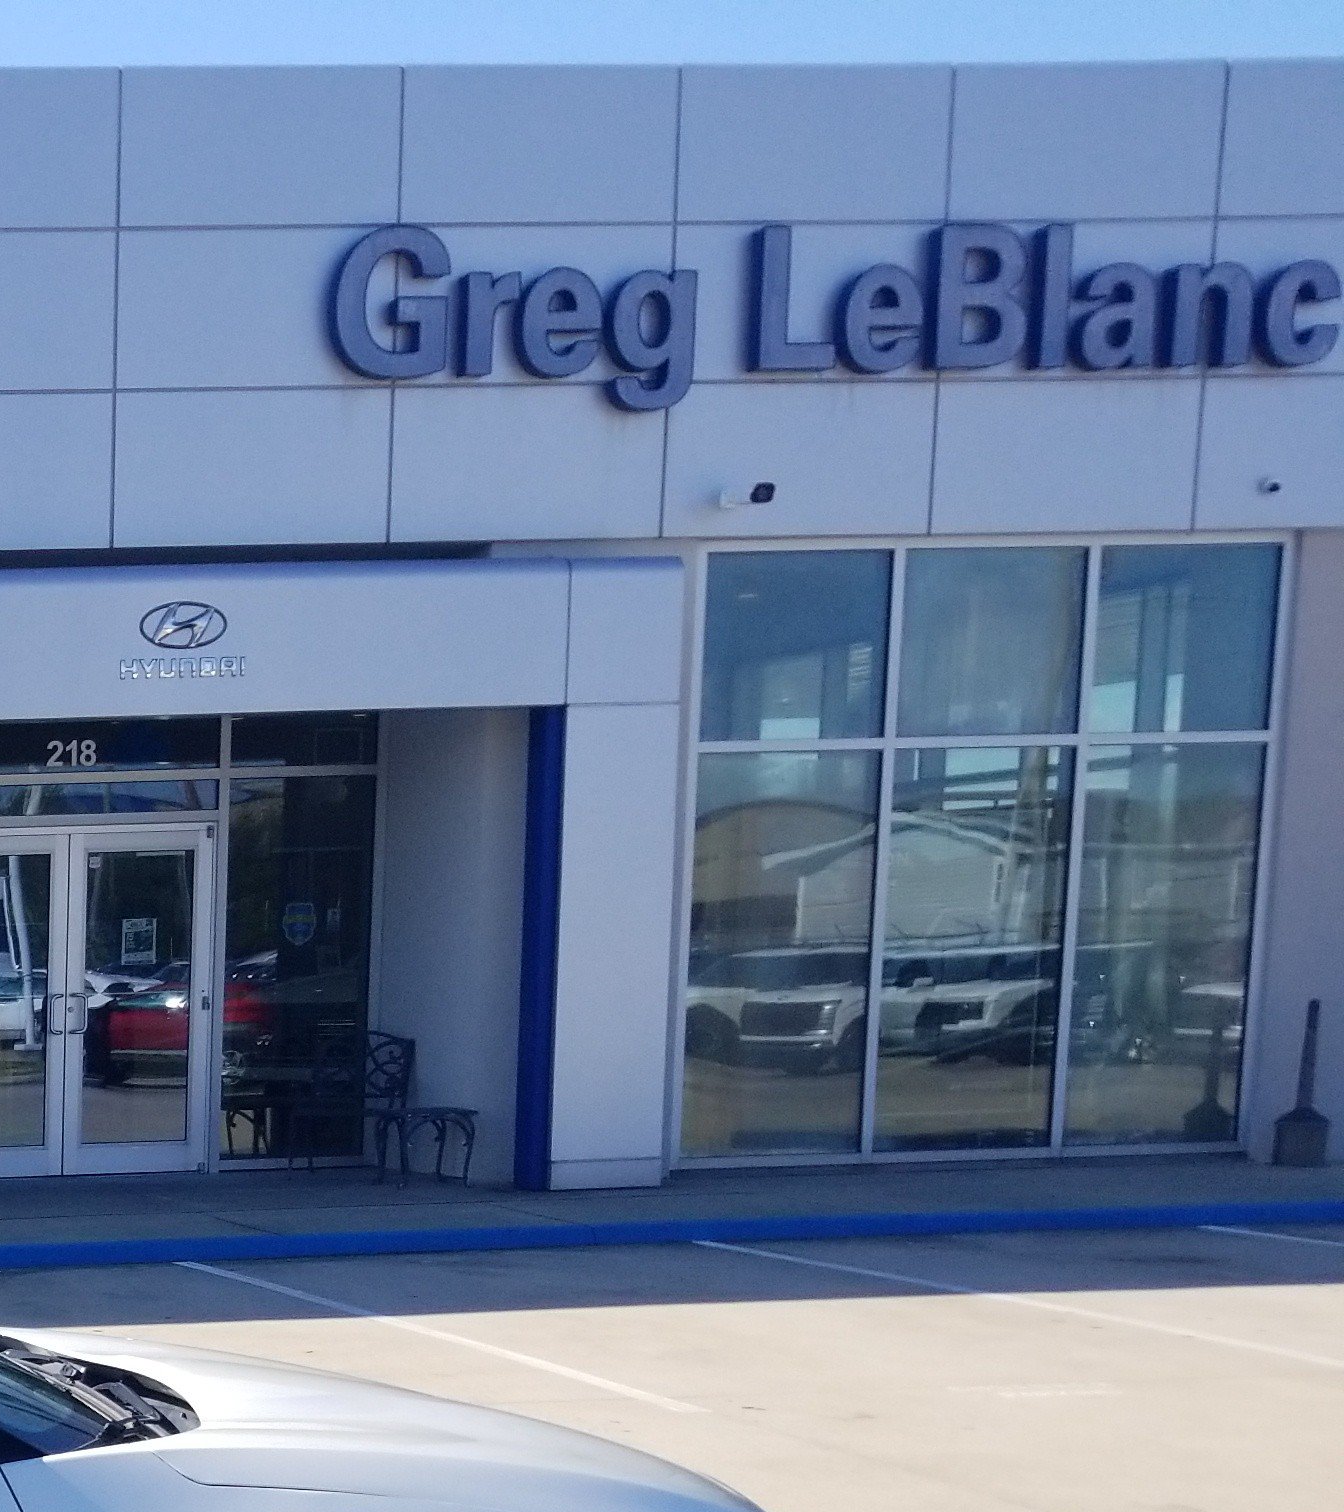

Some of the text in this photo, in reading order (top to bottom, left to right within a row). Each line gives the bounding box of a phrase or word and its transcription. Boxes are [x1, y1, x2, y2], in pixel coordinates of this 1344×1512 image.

[328, 222, 1342, 411] Greg LeBlanc
[119, 656, 246, 680] HYUNDAI
[45, 739, 97, 767] 218
